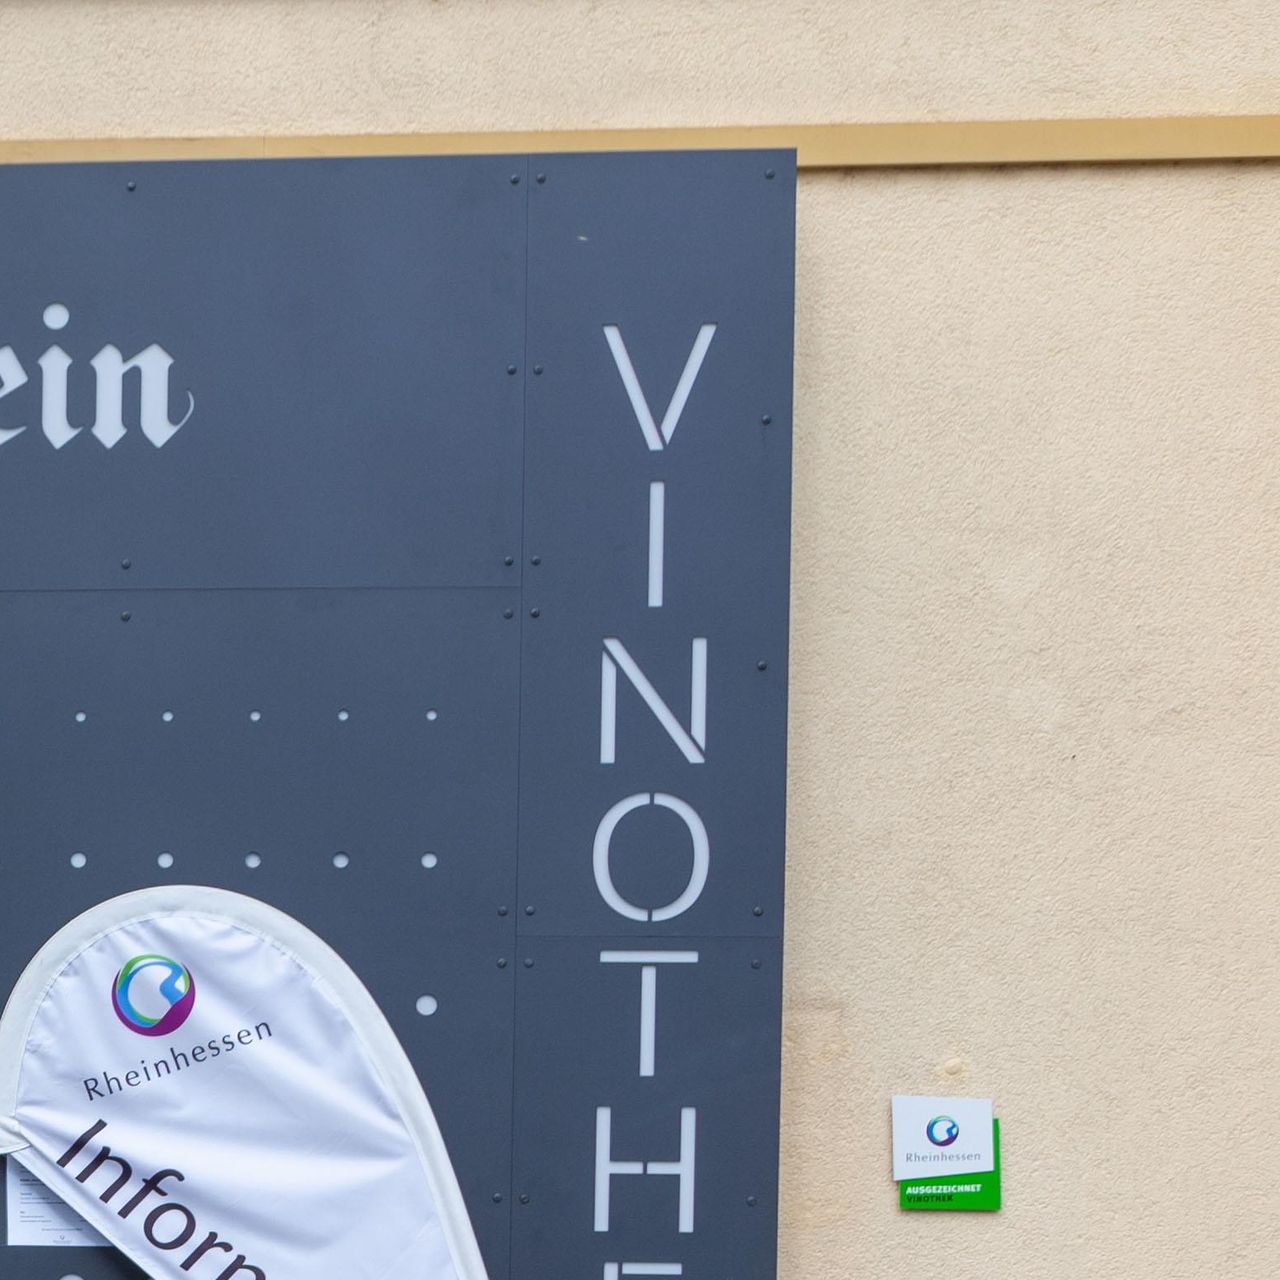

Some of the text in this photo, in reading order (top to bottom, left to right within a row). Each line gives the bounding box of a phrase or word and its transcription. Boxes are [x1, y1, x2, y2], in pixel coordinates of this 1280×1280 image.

[83, 1016, 273, 1101] Rheinhessen
[906, 1152, 981, 1162] Rheinhessen
[906, 1184, 981, 1194] AUSGEZEICHNET
